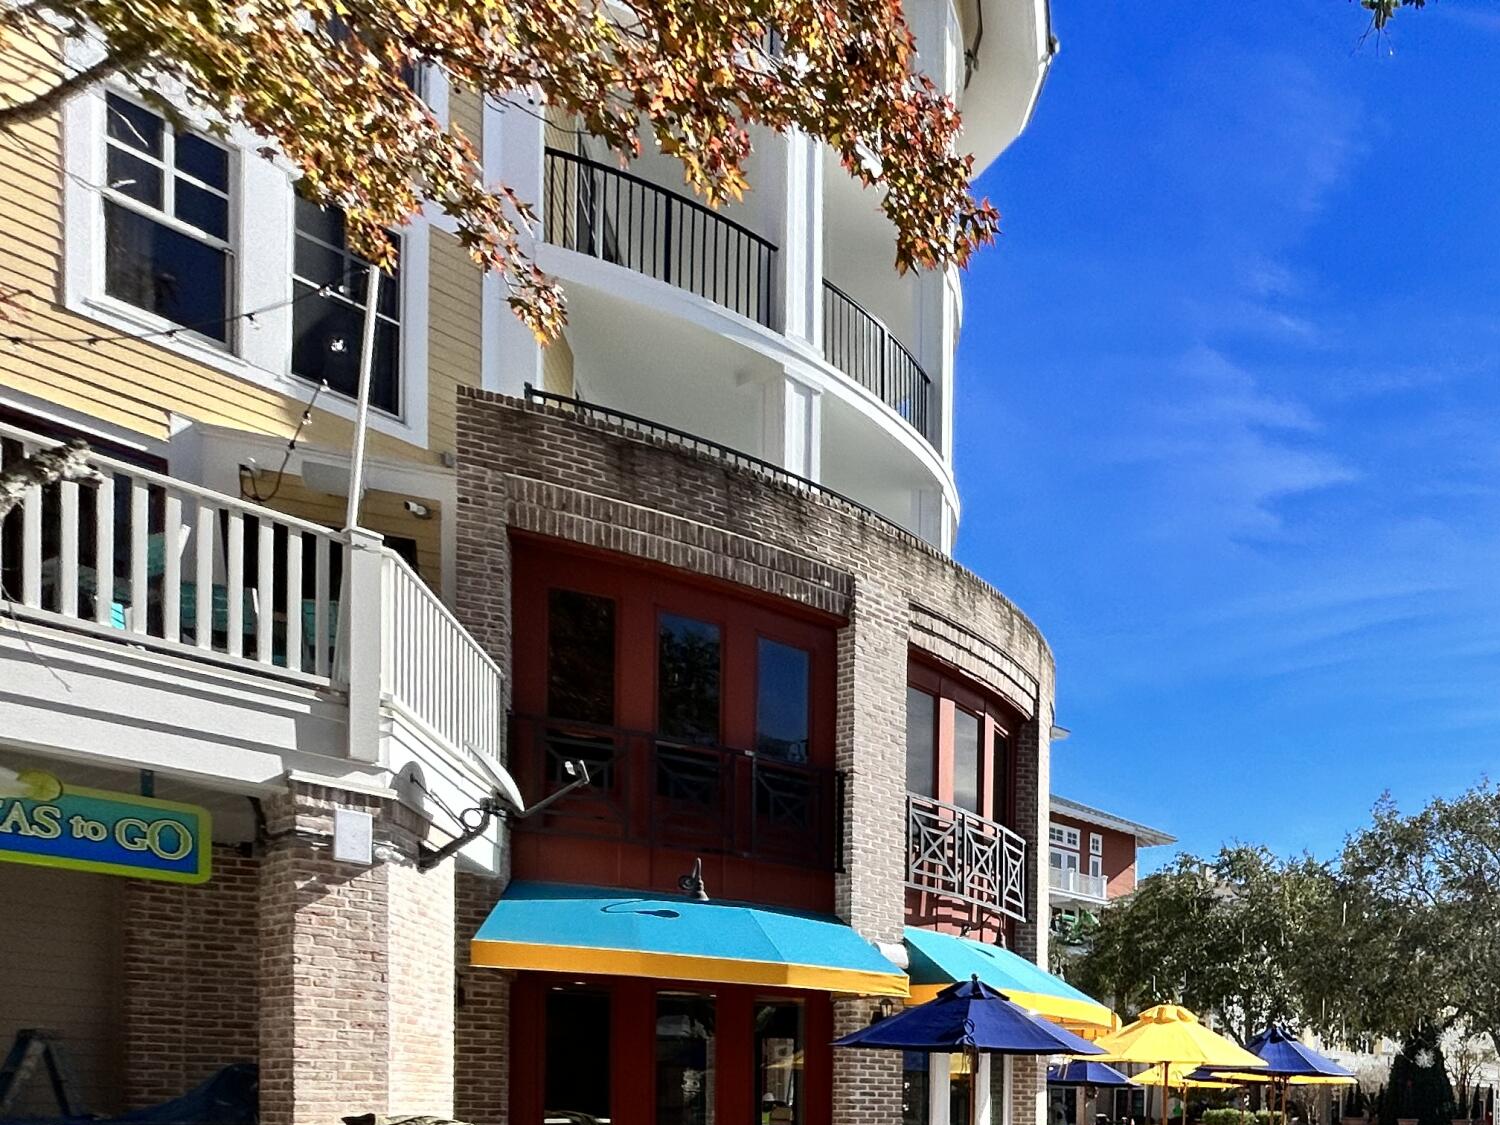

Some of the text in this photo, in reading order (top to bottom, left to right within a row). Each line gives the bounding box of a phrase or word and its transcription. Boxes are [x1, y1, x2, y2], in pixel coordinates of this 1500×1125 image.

[0, 799, 193, 860] AS to GO
